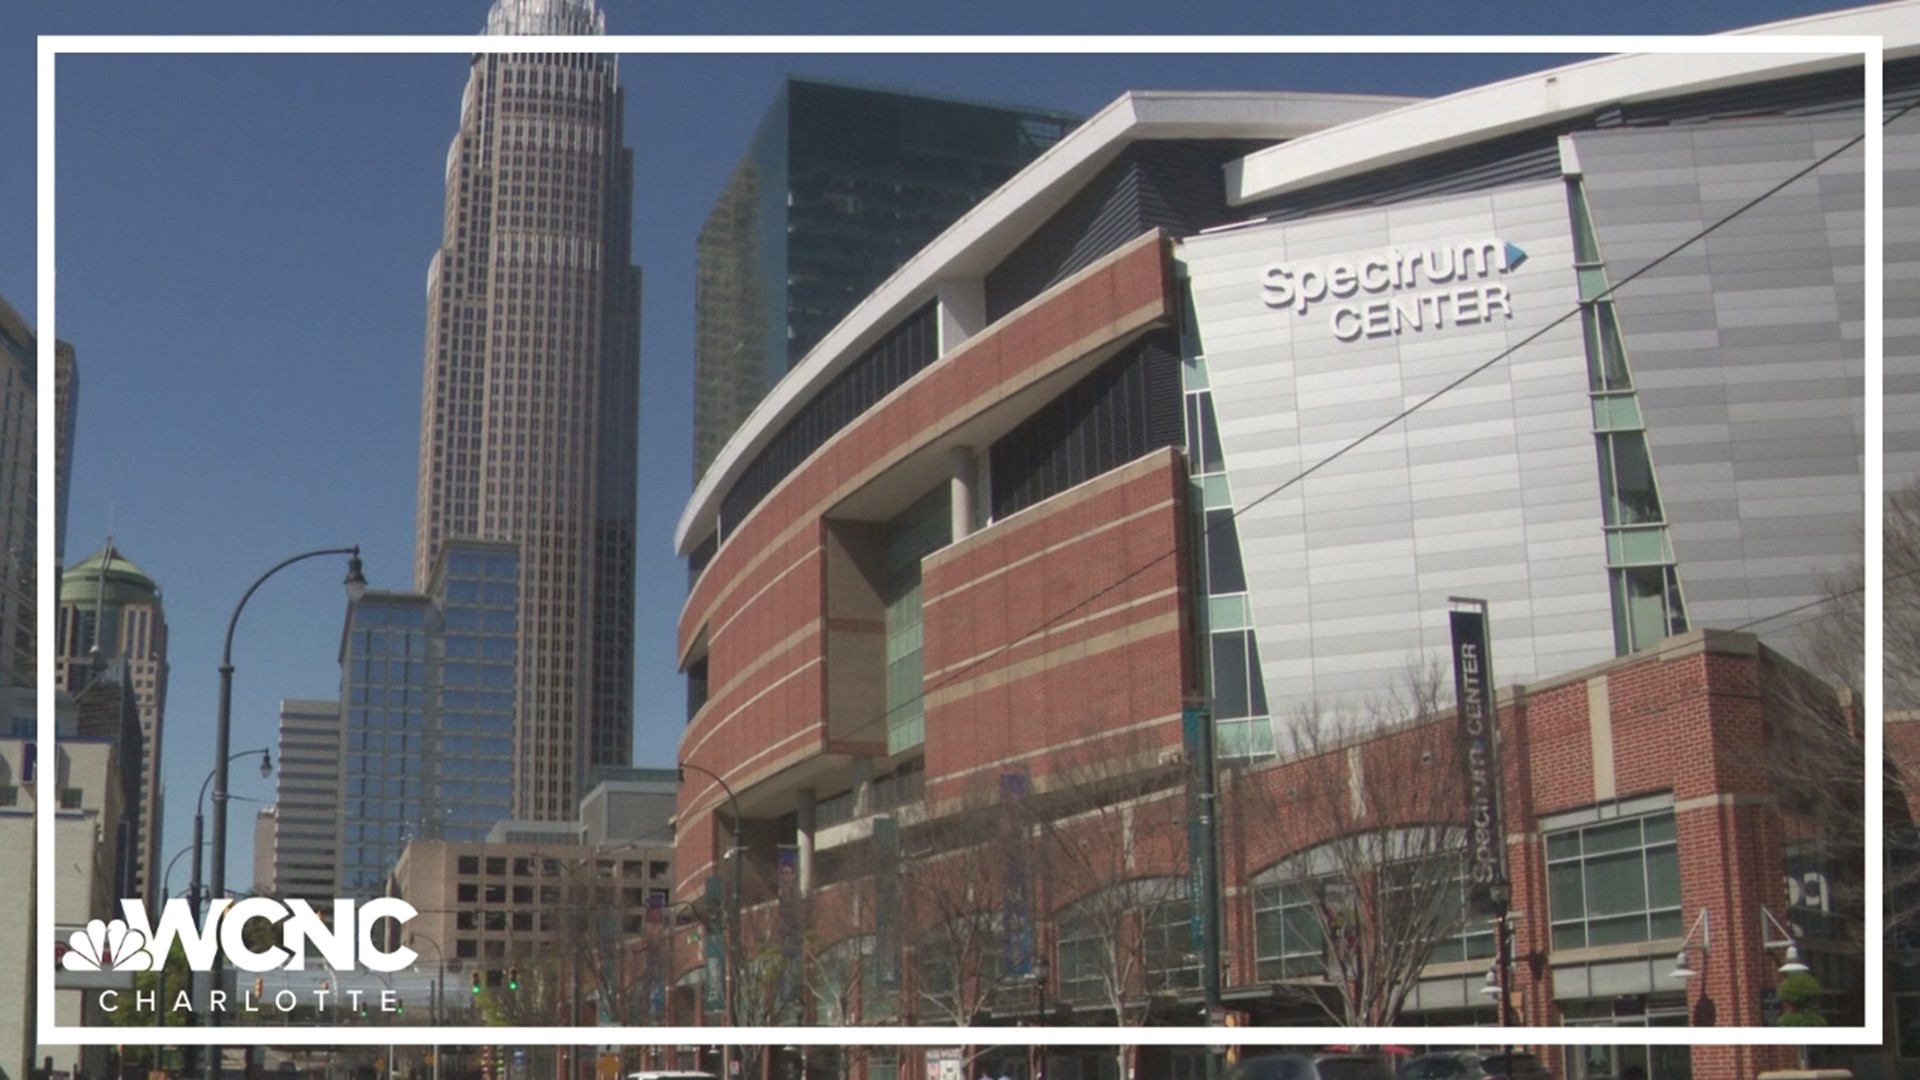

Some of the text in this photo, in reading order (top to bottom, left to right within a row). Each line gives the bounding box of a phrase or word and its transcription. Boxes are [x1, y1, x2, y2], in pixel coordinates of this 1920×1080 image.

[1260, 237, 1509, 315] Spectrum
[1329, 282, 1513, 342] CENTER
[1461, 643, 1497, 883] Spectrum CENTER
